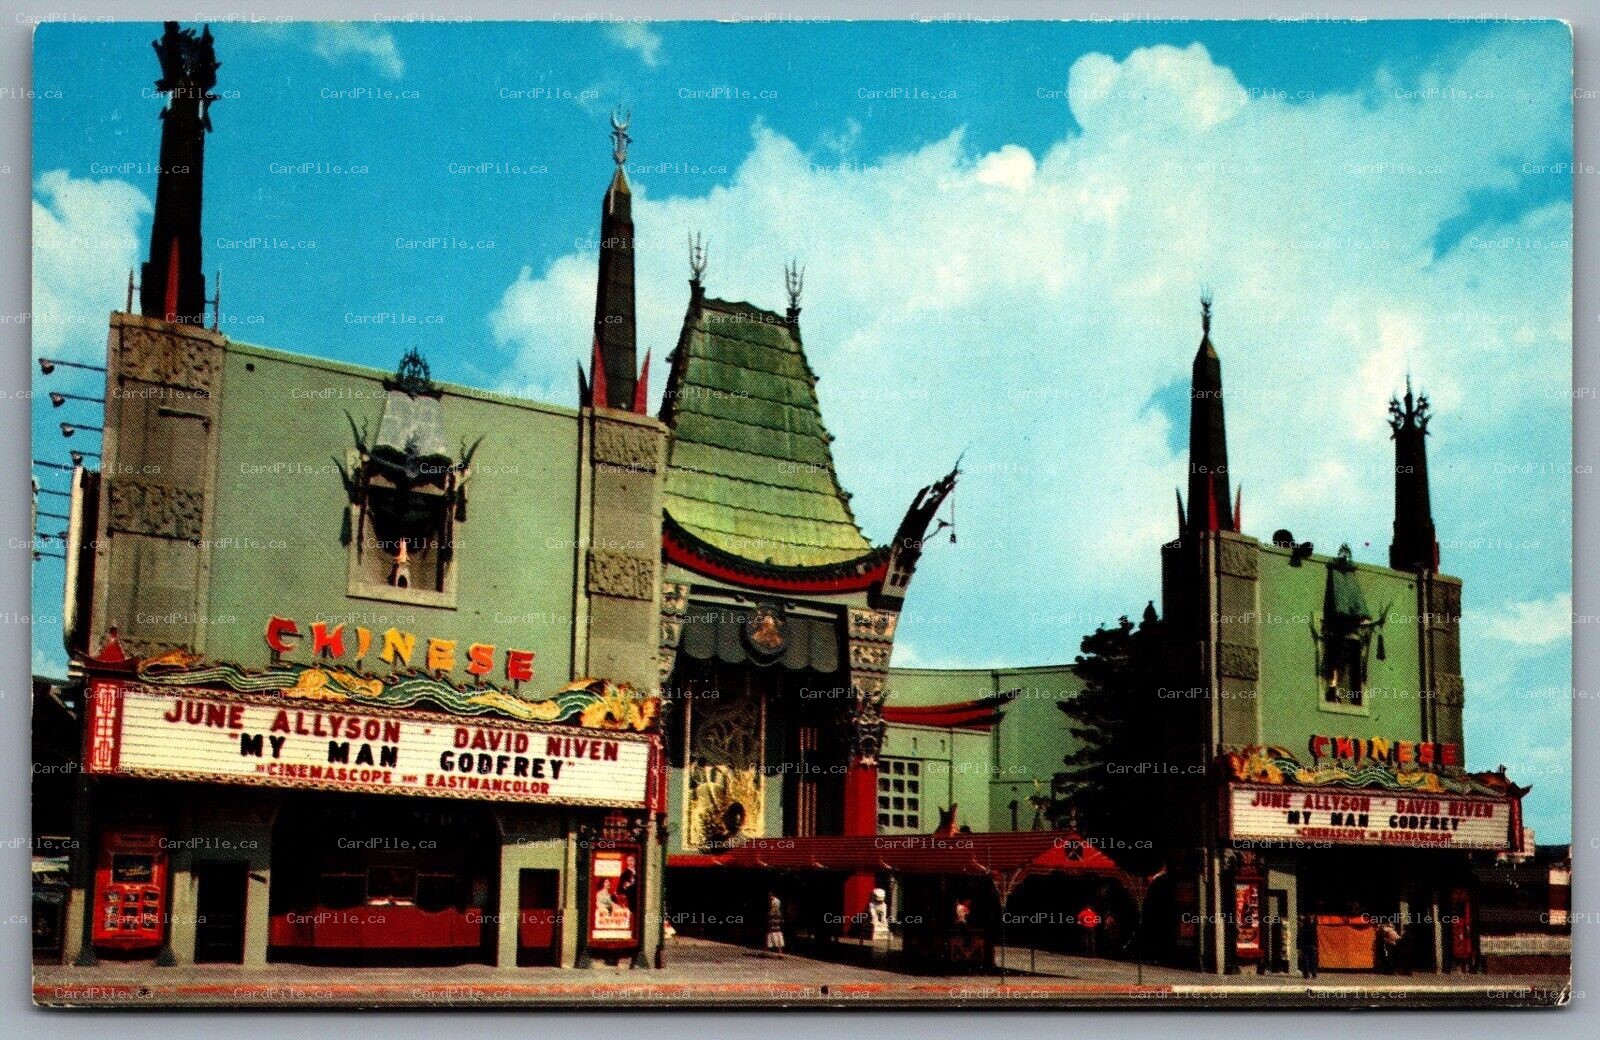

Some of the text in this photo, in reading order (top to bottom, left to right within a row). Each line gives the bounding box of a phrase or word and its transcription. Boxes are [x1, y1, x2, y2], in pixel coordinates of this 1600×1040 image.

[265, 616, 536, 682] CHINESE
[164, 700, 619, 761] JUNE ALLYSON DAVID NIVEN
[328, 740, 399, 768] MAN
[1308, 733, 1458, 767] CHINESE
[268, 763, 393, 784] CINEMASCOPE
[425, 773, 550, 795] EASTMANCOLOR
[1251, 791, 1494, 818] JUNE ALLYSON DAVID NIVEN
[1330, 812, 1369, 827] MAN
